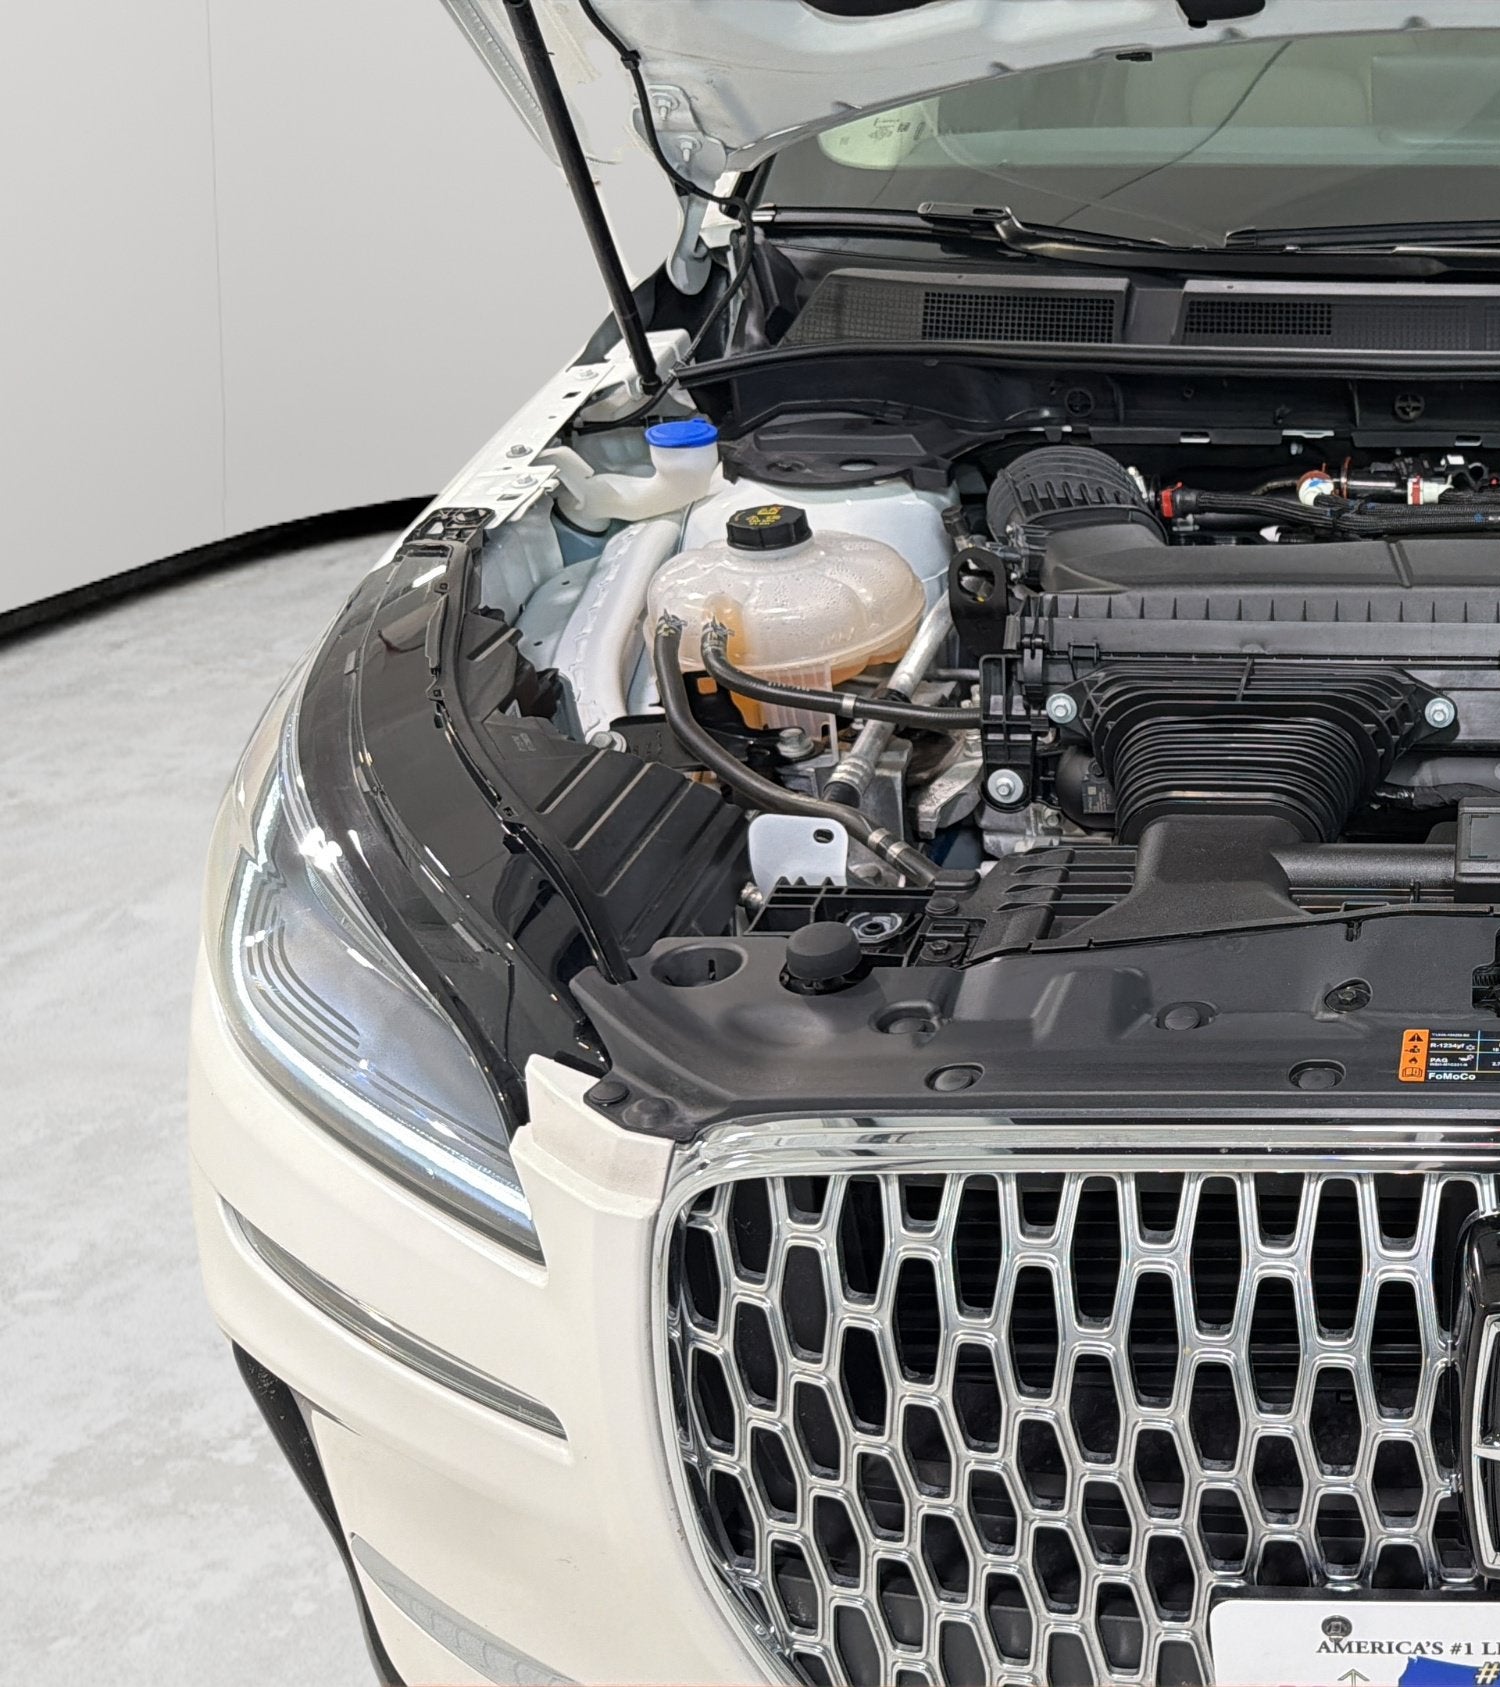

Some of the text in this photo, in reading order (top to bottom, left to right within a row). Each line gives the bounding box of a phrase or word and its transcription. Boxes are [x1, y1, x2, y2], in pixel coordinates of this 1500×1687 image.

[1430, 1042, 1466, 1050] R-1234yf
[1428, 1072, 1477, 1080] FoMoCo
[1316, 1640, 1444, 1655] AMERICA'S
[1449, 1641, 1474, 1655] #1
